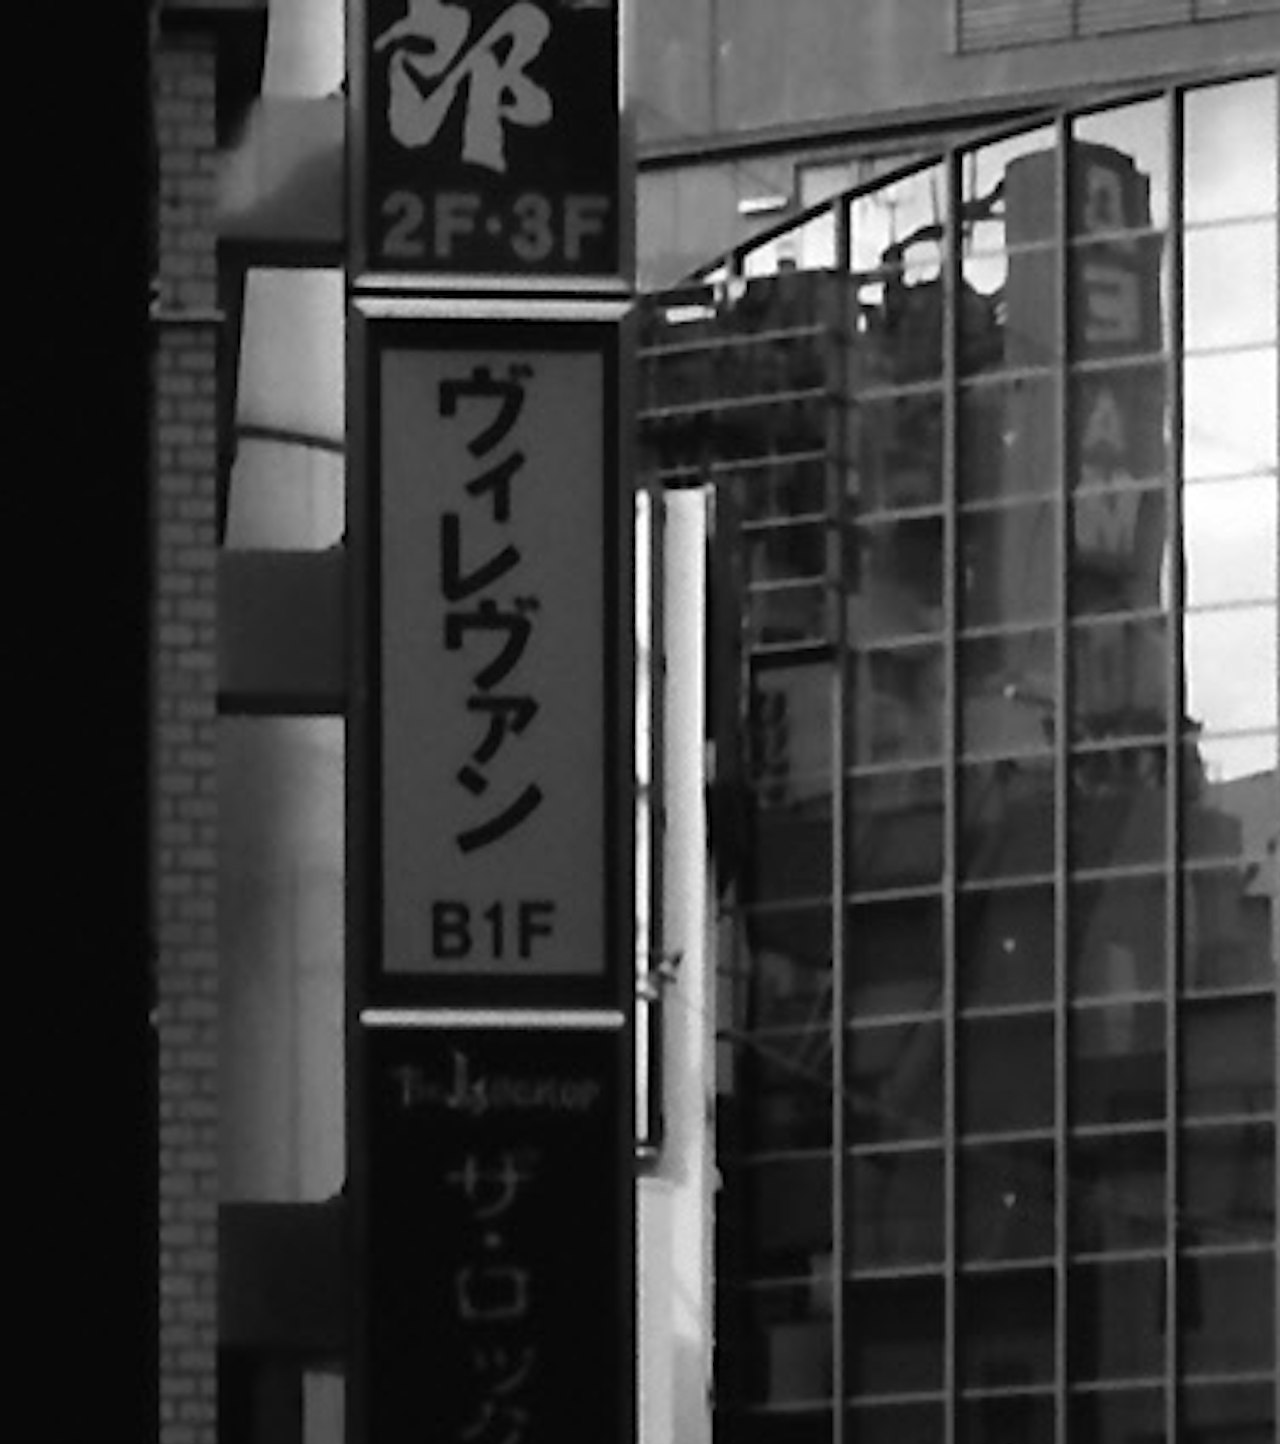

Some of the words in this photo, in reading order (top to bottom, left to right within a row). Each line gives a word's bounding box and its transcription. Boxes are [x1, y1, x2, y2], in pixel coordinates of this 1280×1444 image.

[439, 364, 544, 854] ヴィレヴァン
[432, 902, 556, 959] B1F
